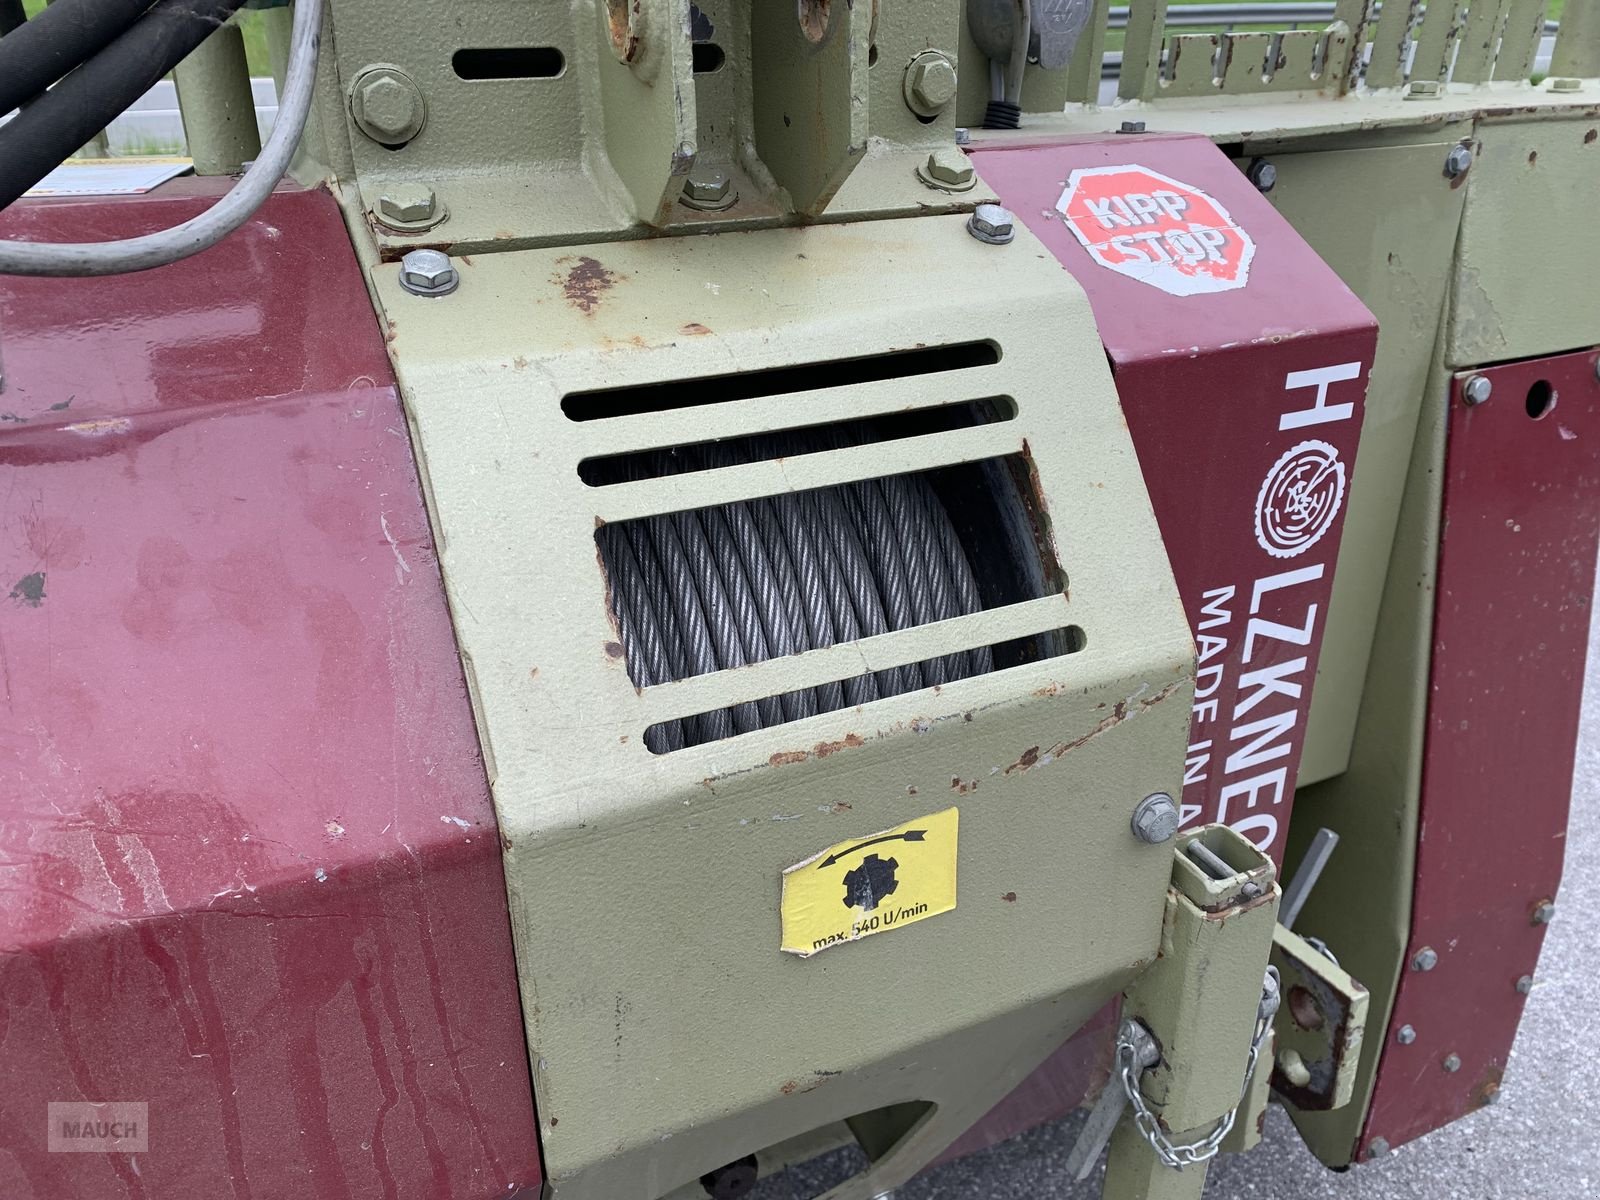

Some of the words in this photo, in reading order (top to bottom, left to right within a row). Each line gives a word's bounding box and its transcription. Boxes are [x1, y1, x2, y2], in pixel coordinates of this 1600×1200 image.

[1083, 189, 1187, 228] KIPP
[1111, 223, 1226, 265] STOP
[1193, 585, 1236, 722] MADE
[1184, 740, 1212, 785] IN
[813, 931, 848, 949] max.
[852, 916, 879, 936] 540
[884, 902, 928, 926] U/min
